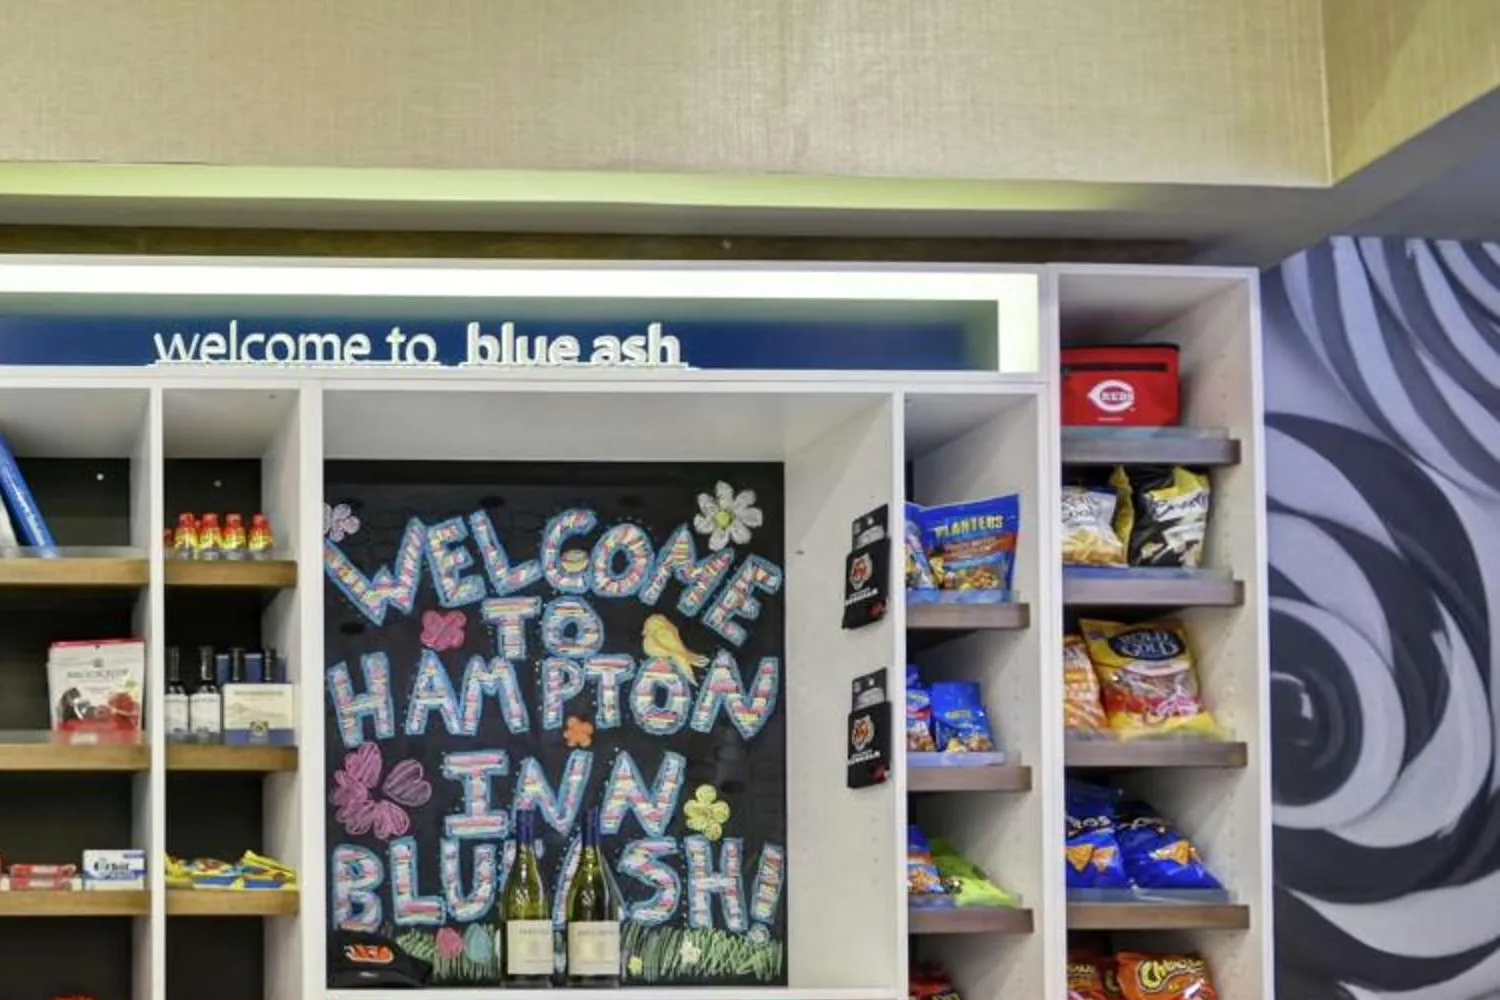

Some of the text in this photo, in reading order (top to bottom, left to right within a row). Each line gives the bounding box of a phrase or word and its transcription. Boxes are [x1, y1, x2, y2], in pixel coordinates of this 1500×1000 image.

[153, 319, 682, 366] welcome to blue ash
[324, 508, 783, 646] WELCOME
[482, 596, 603, 660] TO
[327, 649, 780, 748] HAMPTON
[442, 749, 687, 838] INN
[331, 836, 544, 933] BLU
